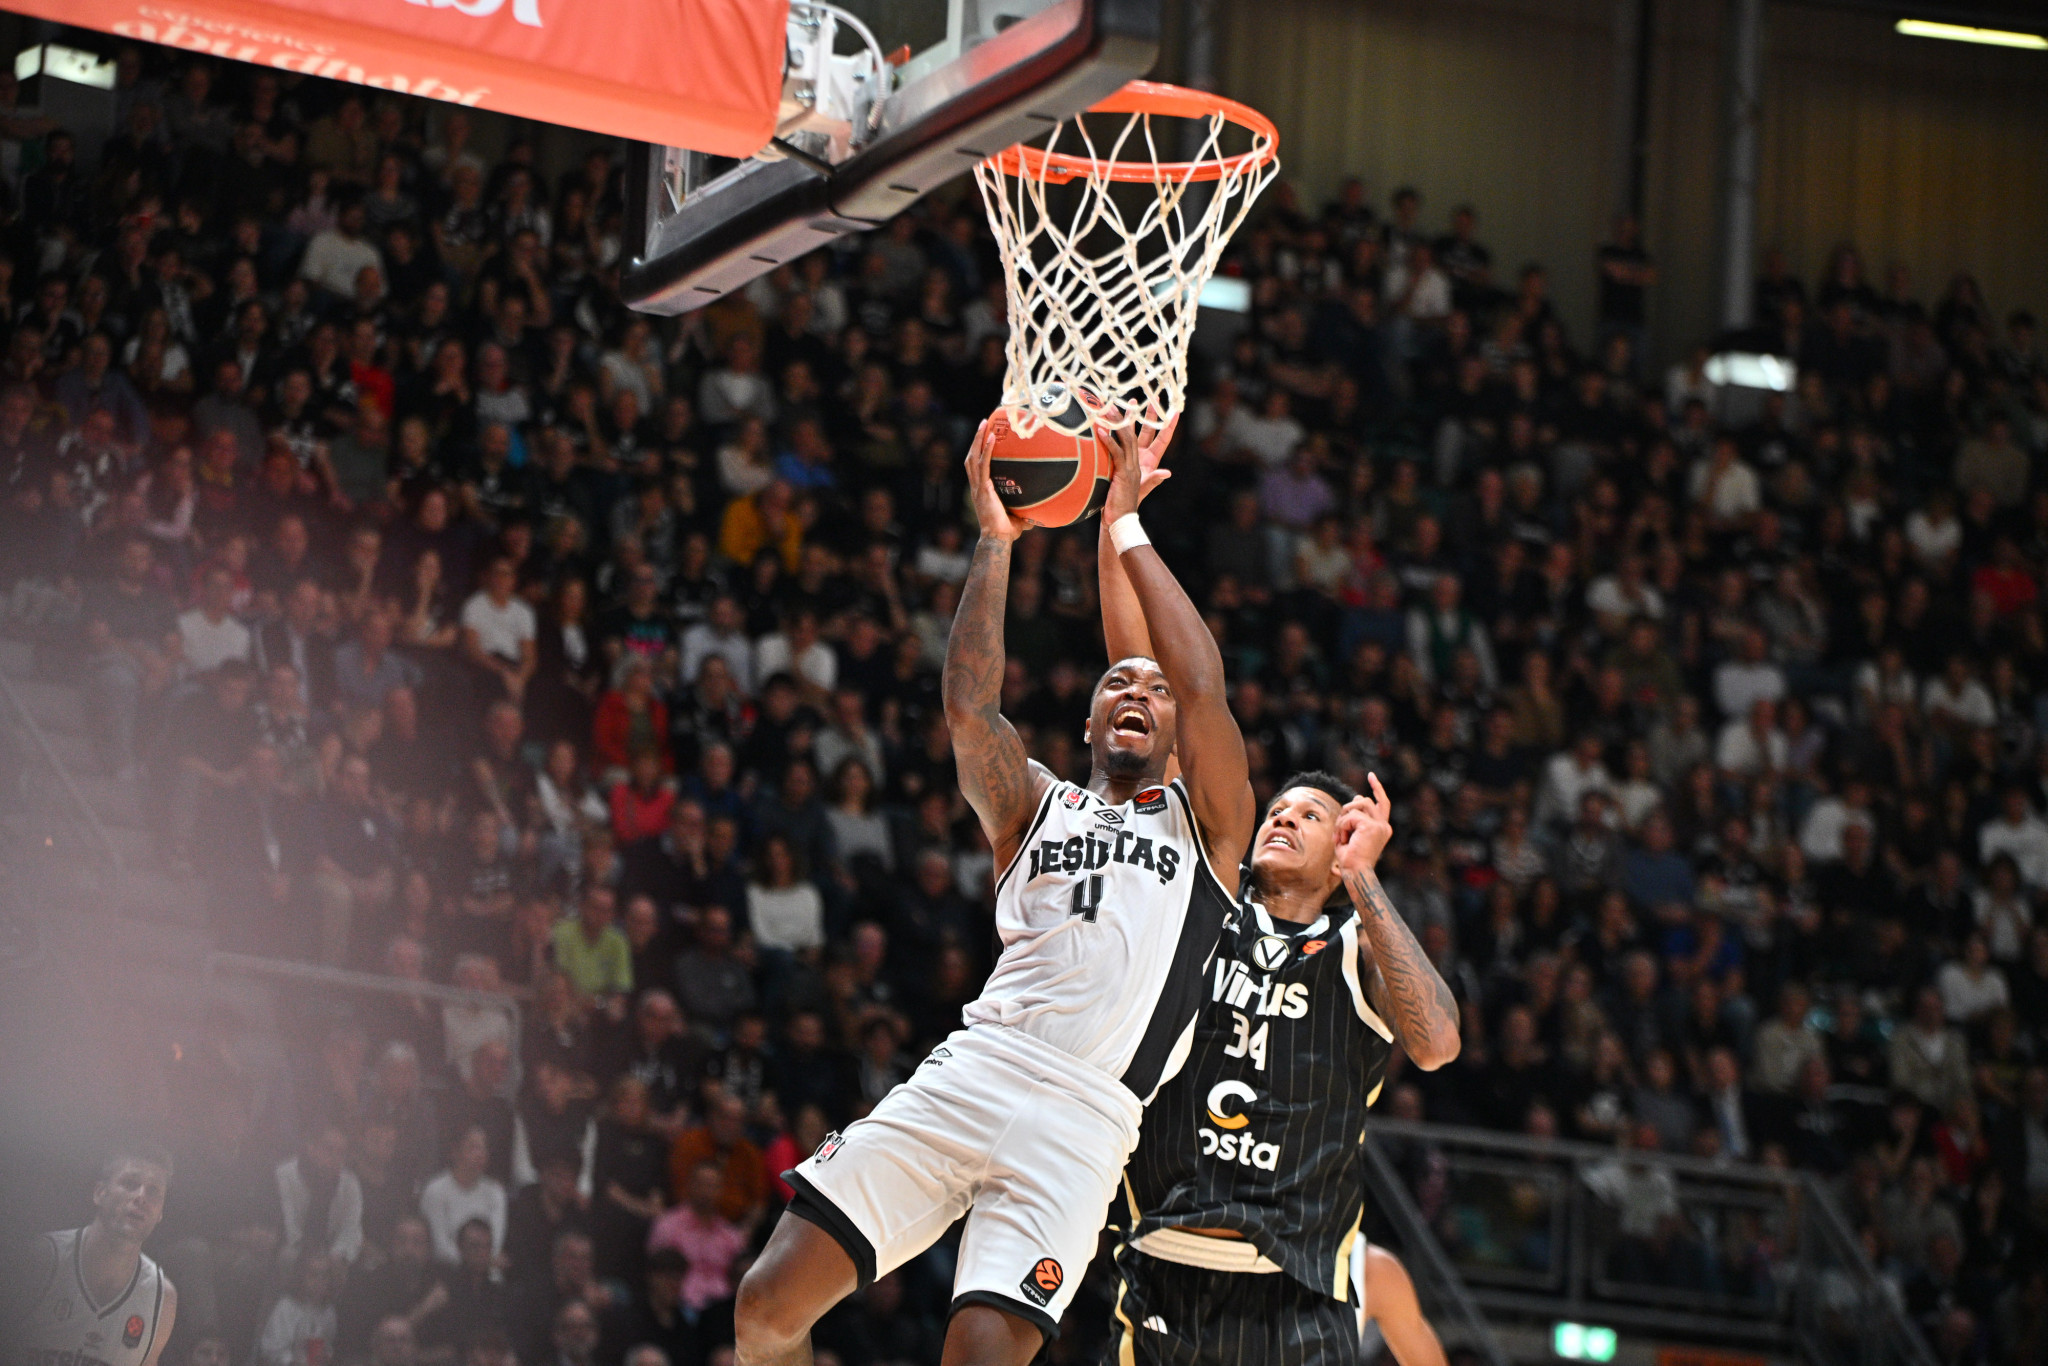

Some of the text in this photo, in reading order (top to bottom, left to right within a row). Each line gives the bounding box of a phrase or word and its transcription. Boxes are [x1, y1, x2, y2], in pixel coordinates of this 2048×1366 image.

[1069, 873, 1104, 923] 4
[1211, 957, 1309, 1019] Virtus
[1223, 1010, 1269, 1071] 34
